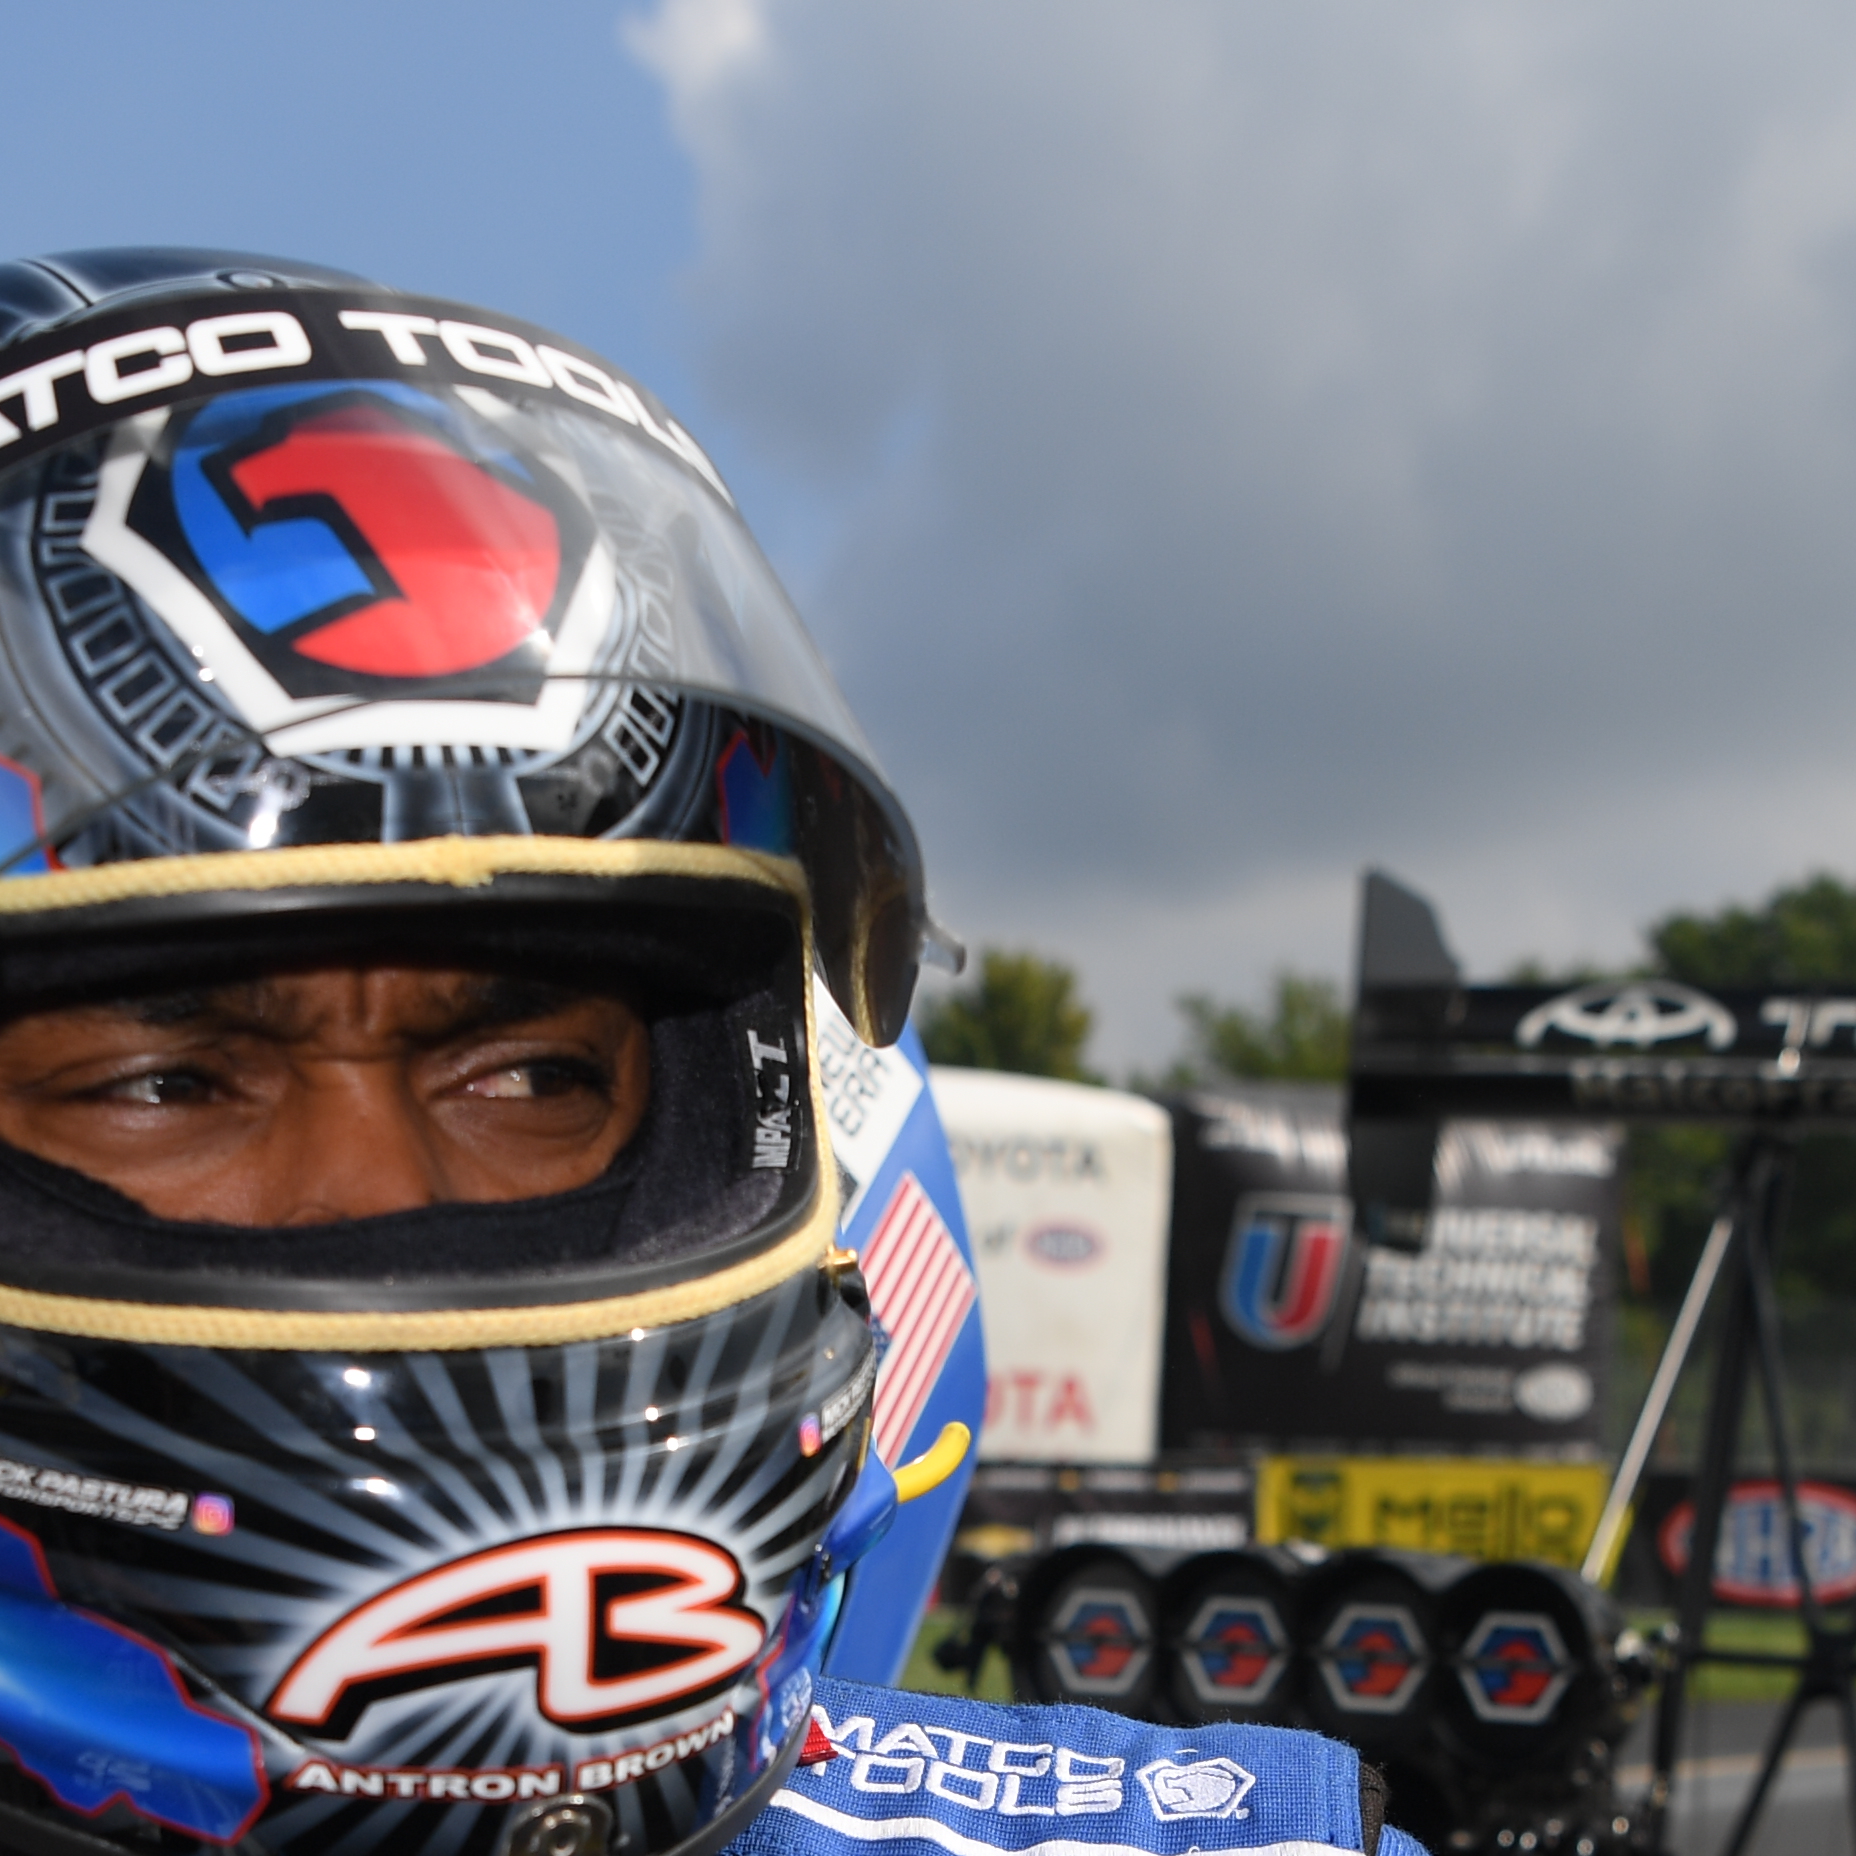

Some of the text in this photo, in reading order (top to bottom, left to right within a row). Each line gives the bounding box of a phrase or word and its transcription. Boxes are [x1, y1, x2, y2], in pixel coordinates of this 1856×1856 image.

[263, 1525, 768, 1725] AB
[290, 1762, 561, 1799] ANTRON
[577, 1708, 737, 1790] BROWN
[809, 1703, 1125, 1781] MATCO
